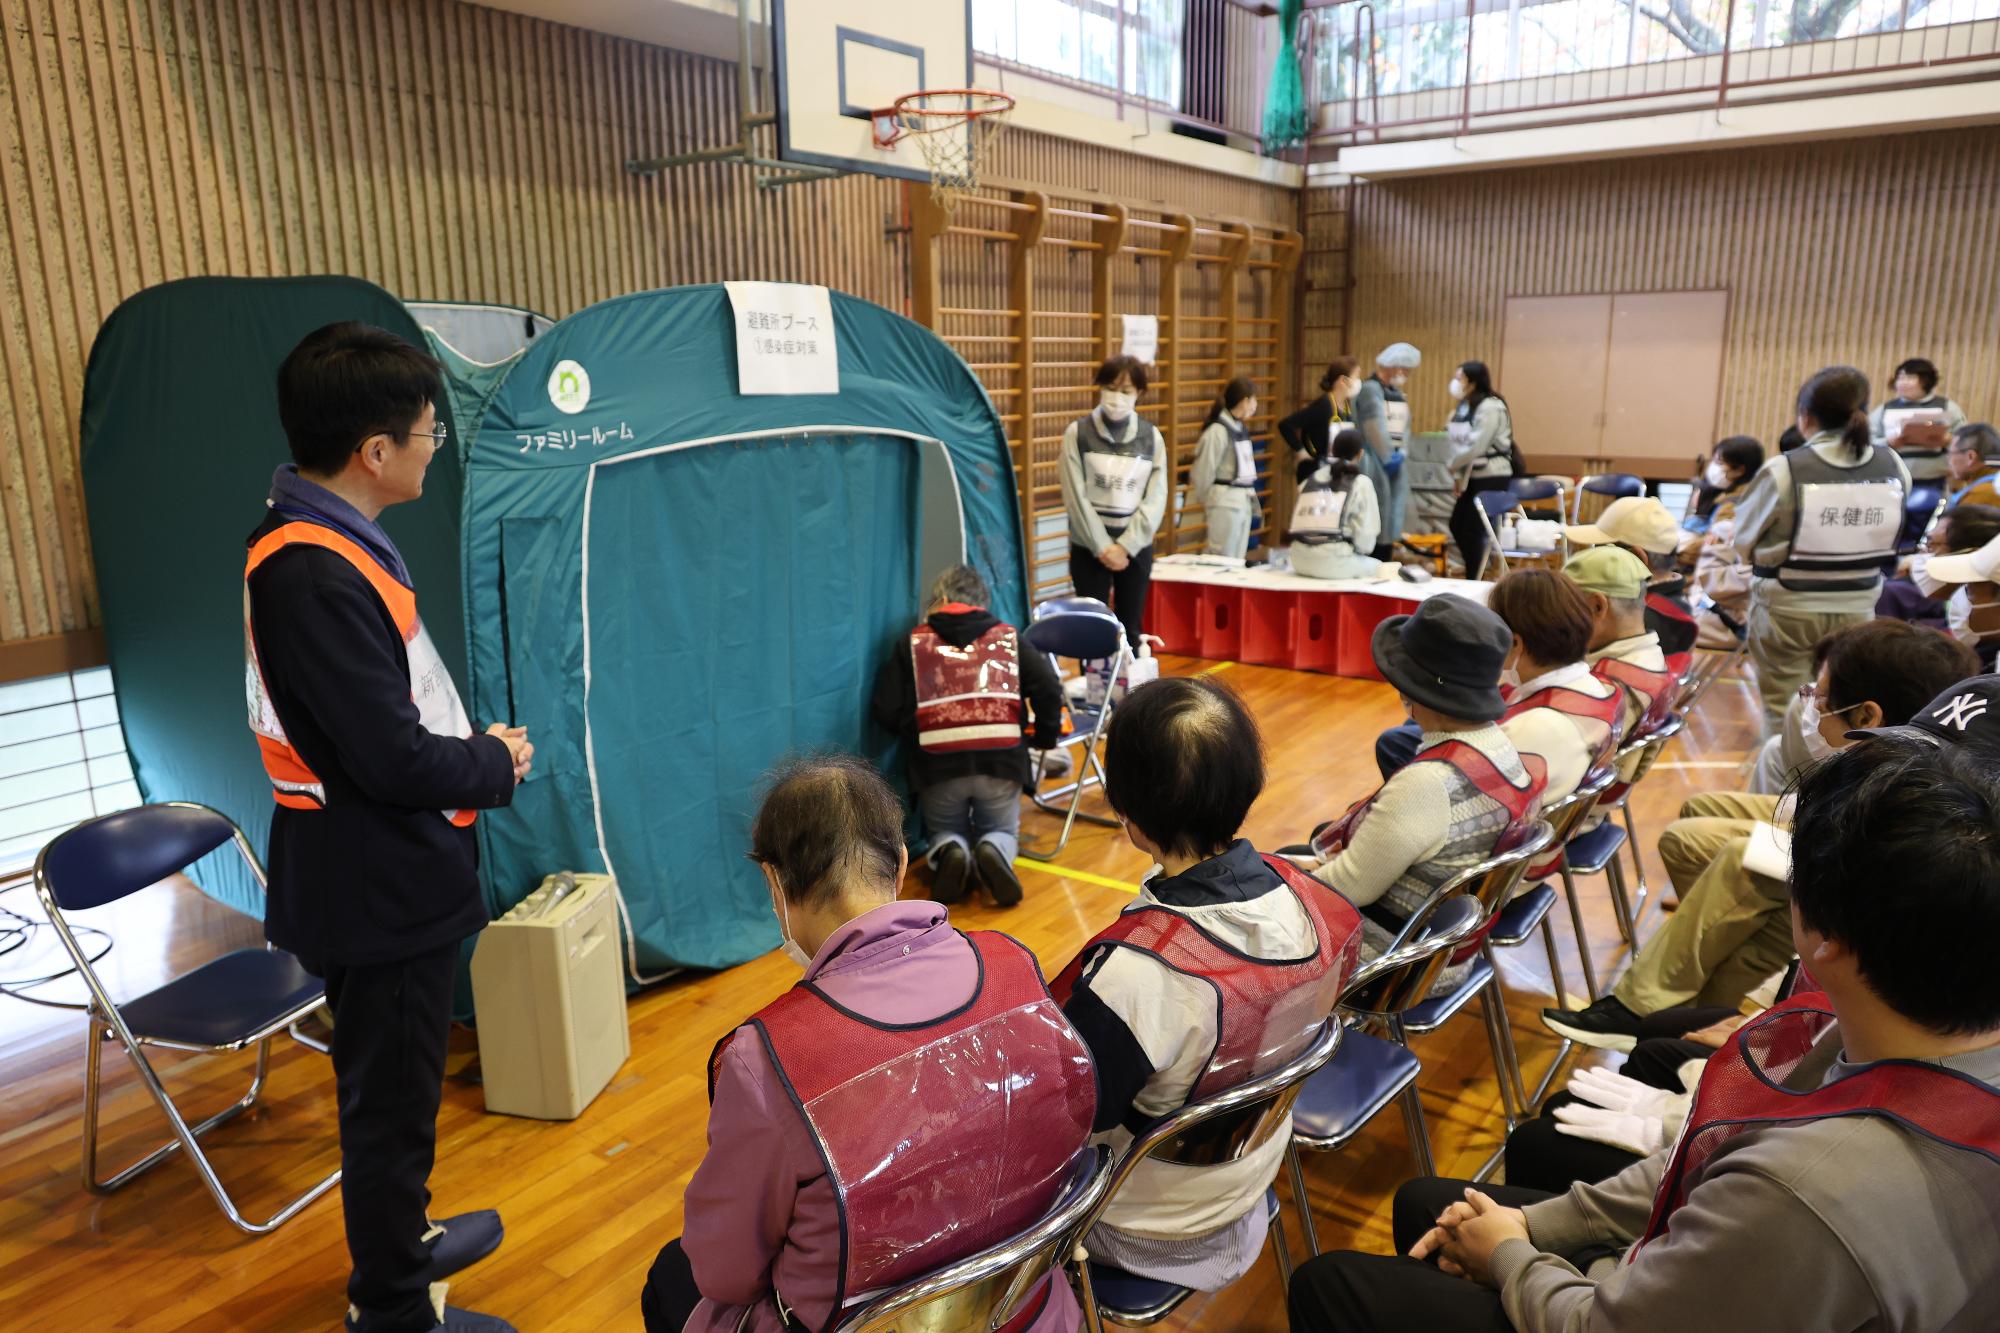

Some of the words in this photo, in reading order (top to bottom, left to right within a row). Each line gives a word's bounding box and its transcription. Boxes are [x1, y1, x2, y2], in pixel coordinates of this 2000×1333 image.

[516, 421, 635, 454] ファミリールーム
[1819, 506, 1885, 527] 保健師
